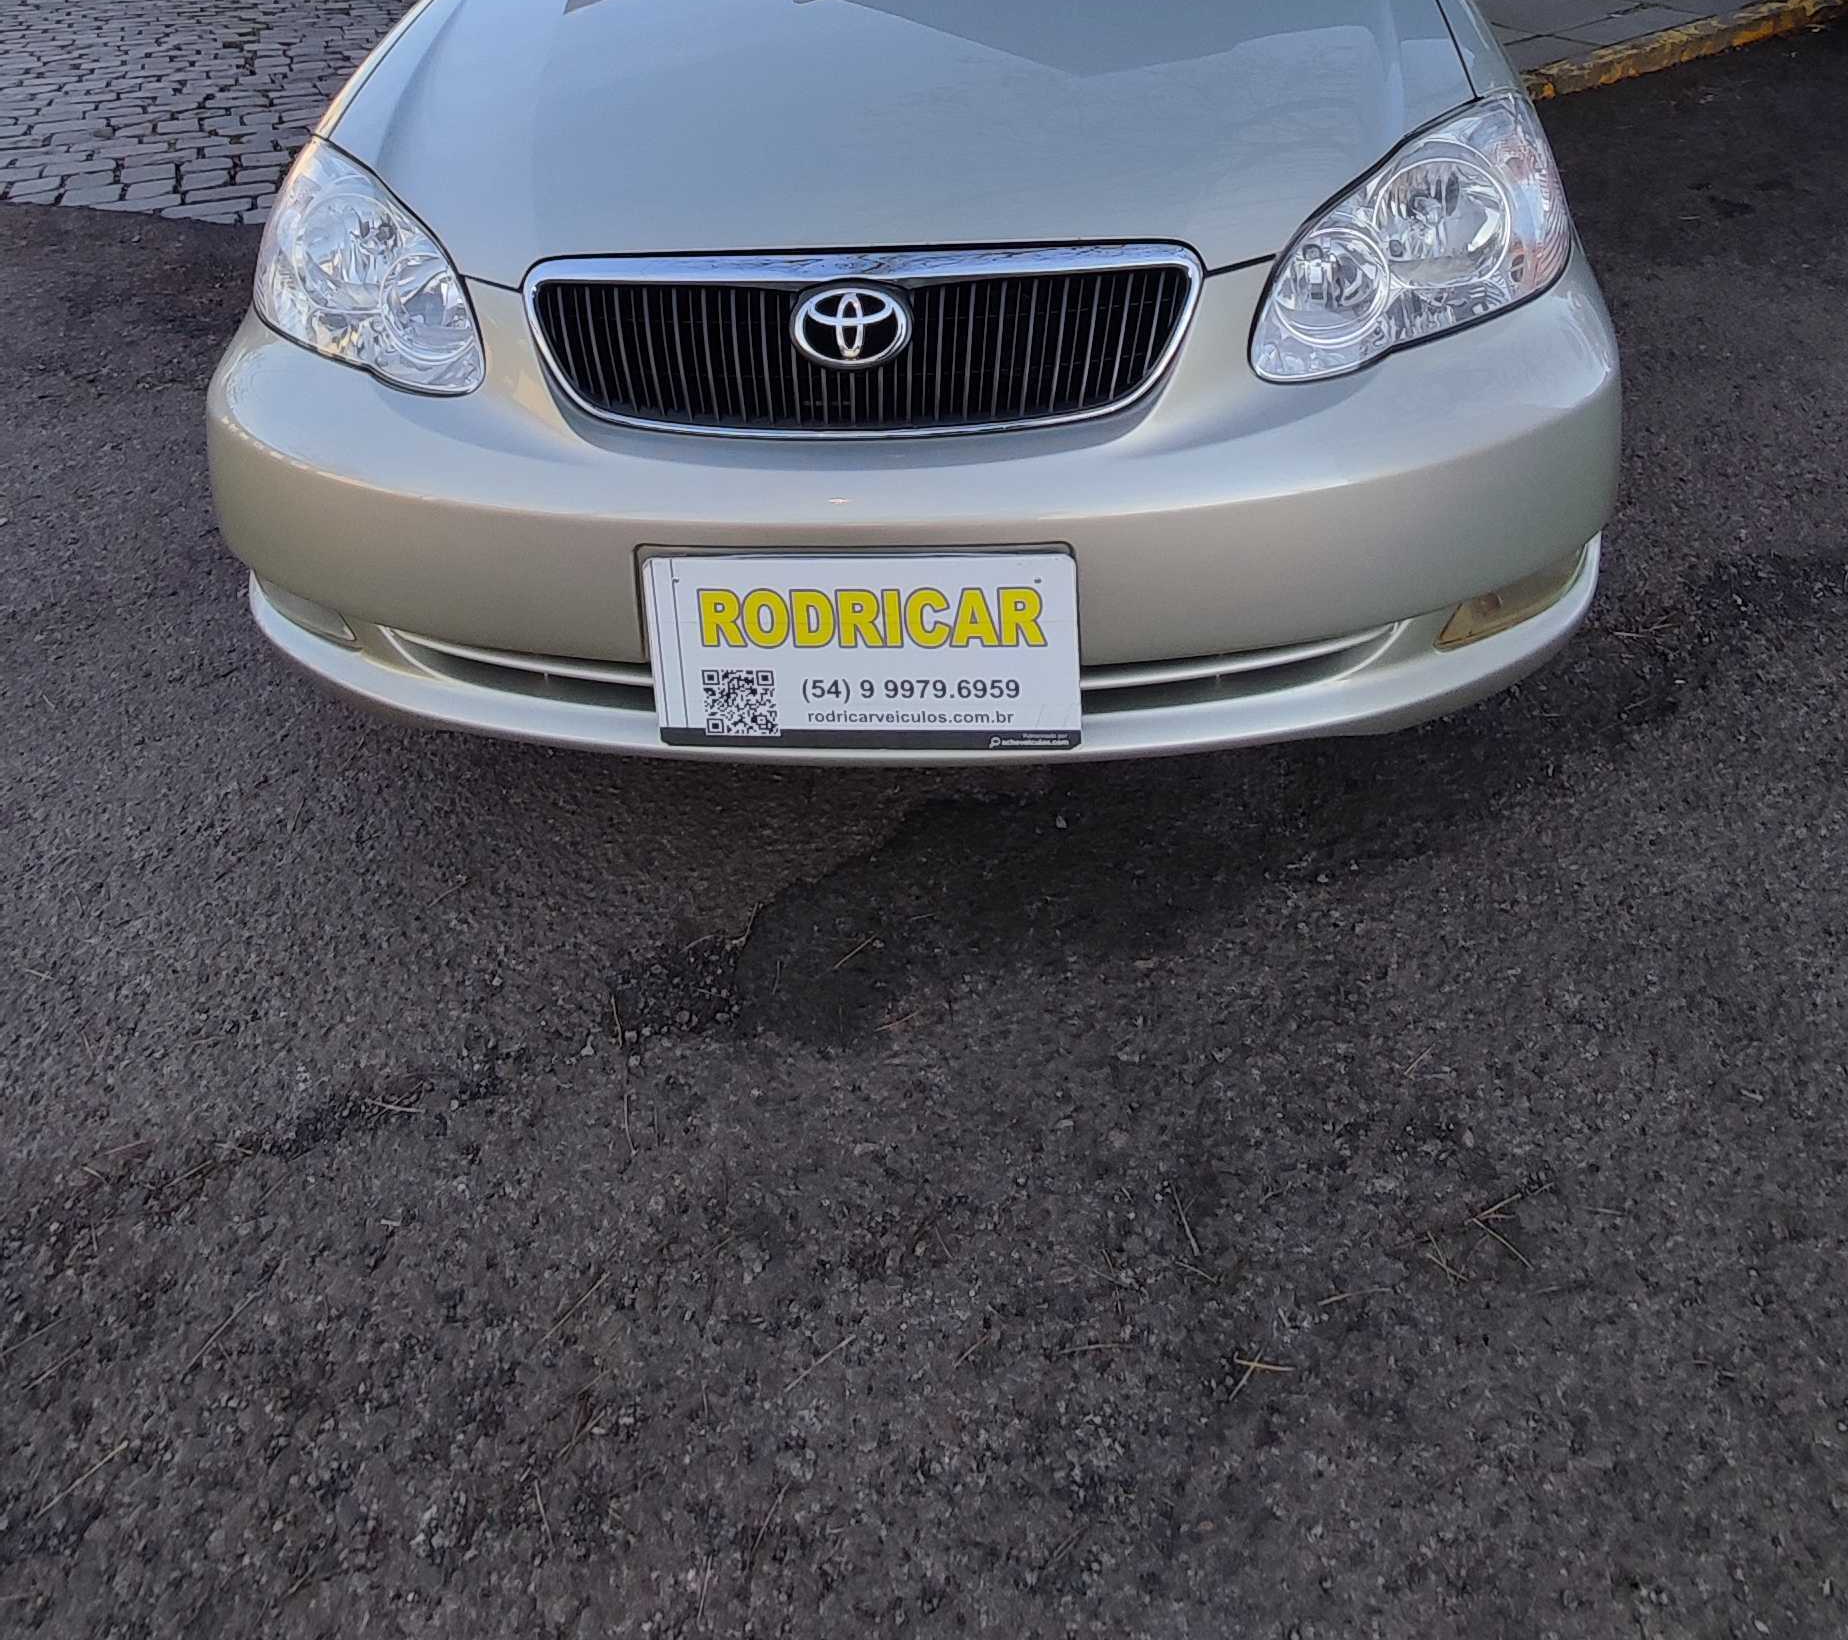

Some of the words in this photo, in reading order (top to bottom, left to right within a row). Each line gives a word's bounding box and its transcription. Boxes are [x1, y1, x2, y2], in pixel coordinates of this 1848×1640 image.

[697, 587, 1047, 649] RODRICAR
[802, 678, 851, 704] (54)
[860, 679, 875, 699] 9
[884, 679, 1021, 699] 9979.6959
[807, 710, 1015, 724] rodricarveiculos.com.br
